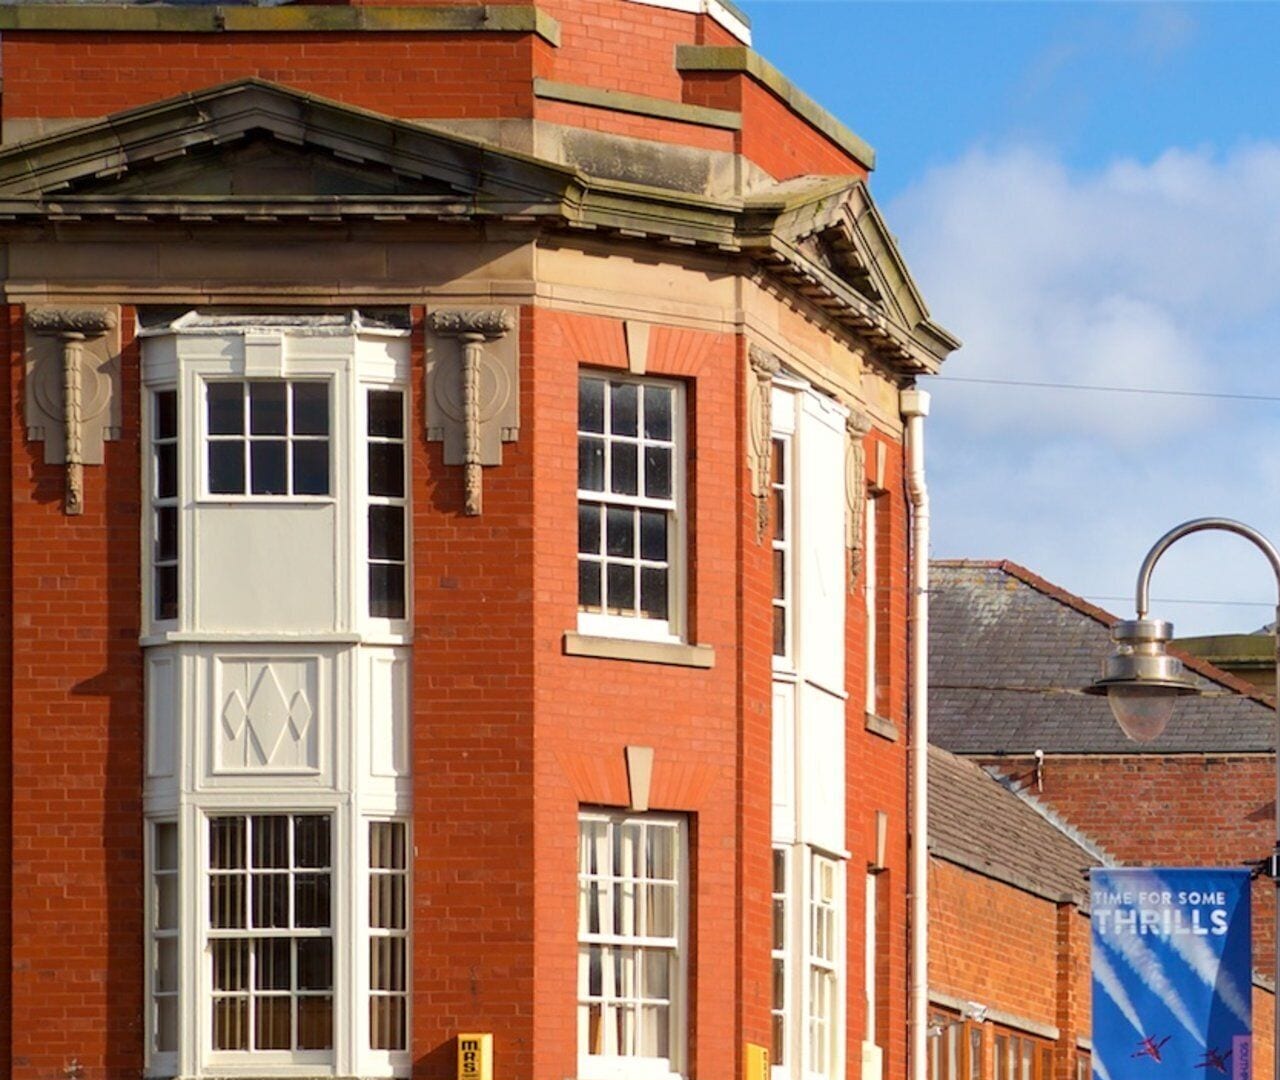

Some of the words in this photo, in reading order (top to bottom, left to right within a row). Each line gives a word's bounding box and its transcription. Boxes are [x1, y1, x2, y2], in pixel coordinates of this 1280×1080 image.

[1094, 892, 1132, 905] TIME
[1139, 892, 1171, 905] FOR
[1179, 892, 1225, 905] SOME
[1093, 909, 1228, 935] THRILLS
